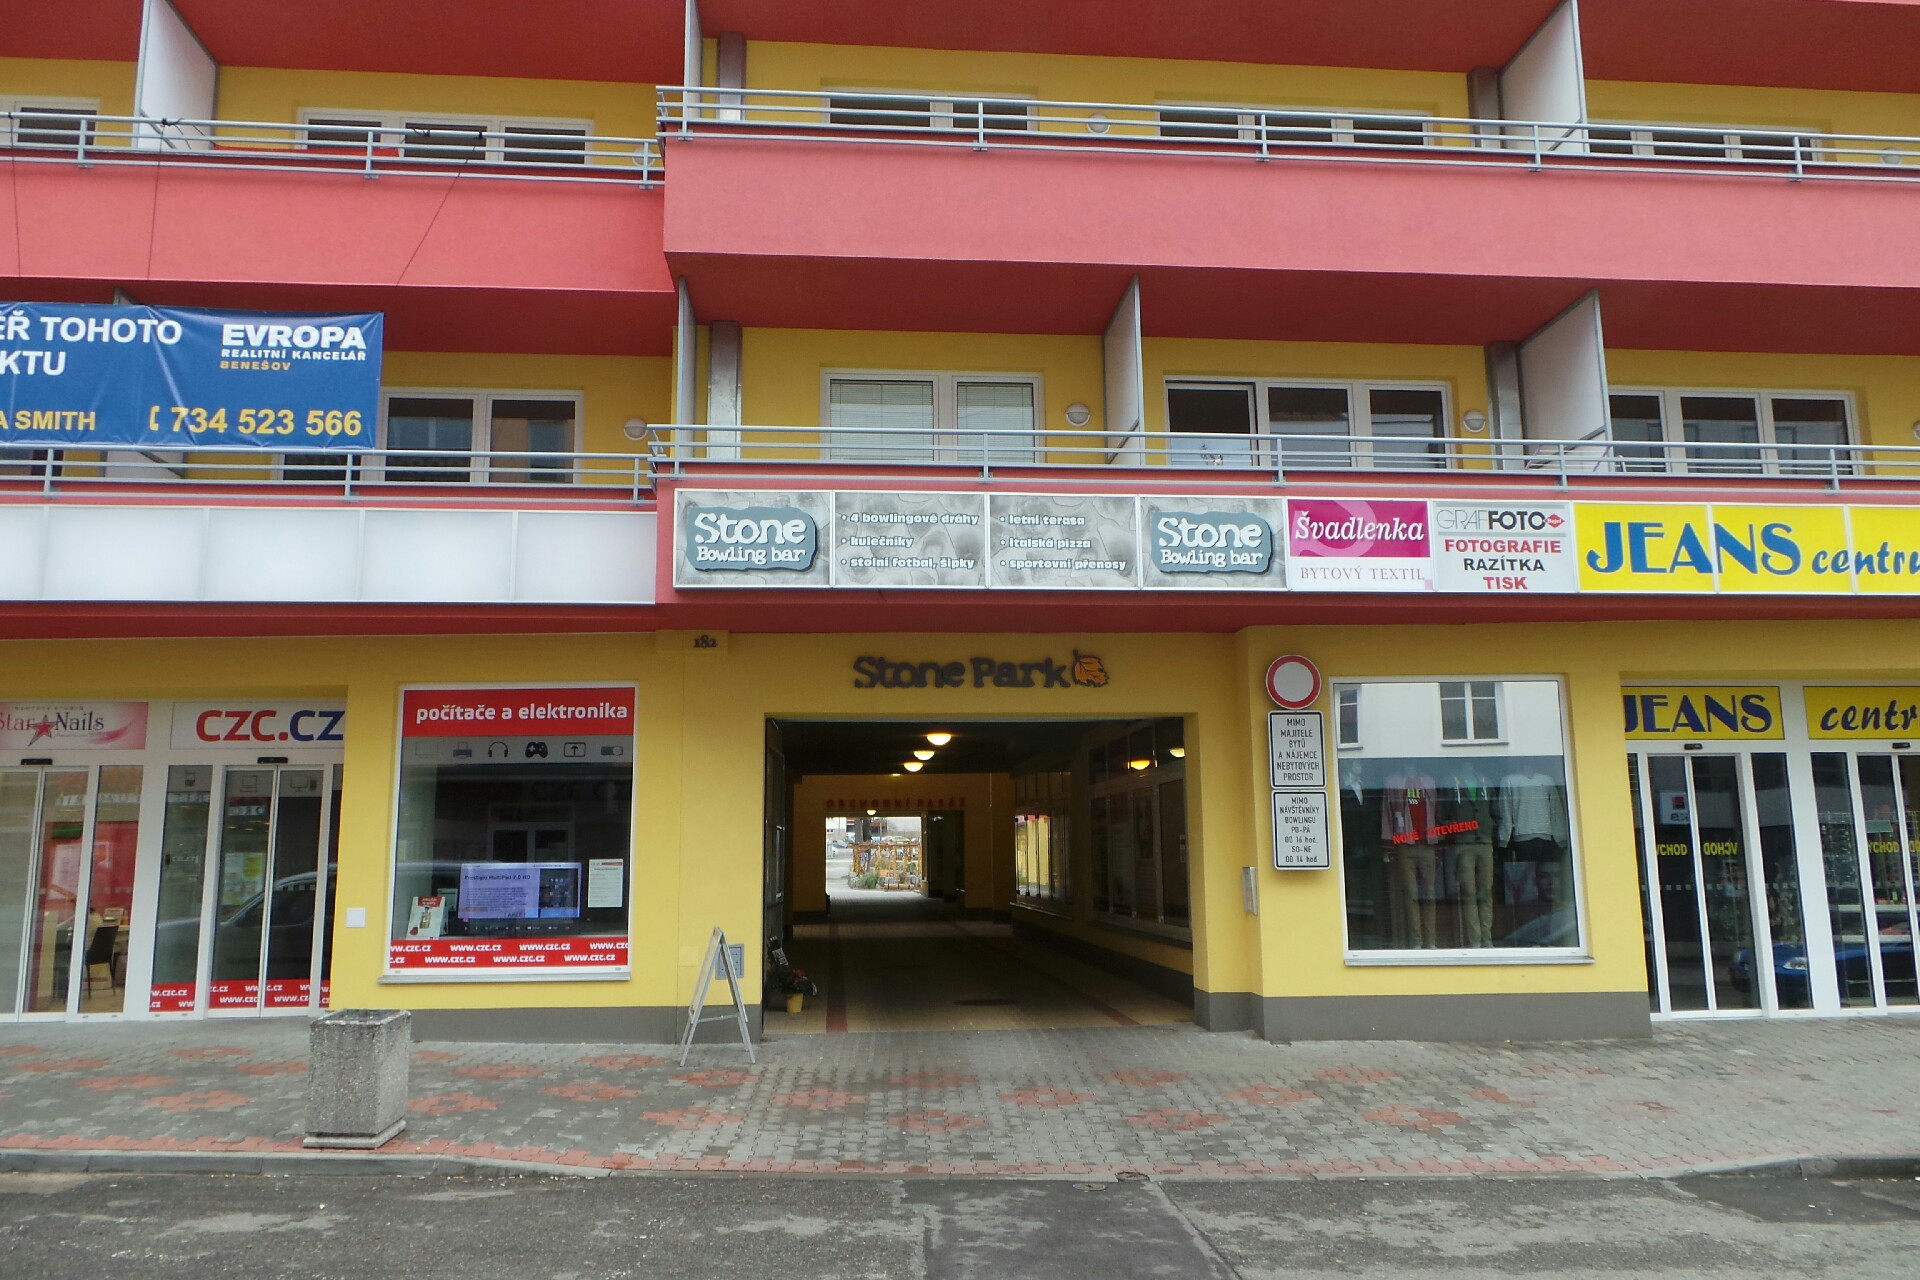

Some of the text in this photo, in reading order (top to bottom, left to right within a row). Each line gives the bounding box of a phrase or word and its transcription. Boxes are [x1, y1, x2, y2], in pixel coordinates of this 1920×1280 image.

[40, 316, 182, 345] TOHOTO
[222, 323, 367, 349] EVROPA
[221, 348, 366, 361] REALITNÍ KANCELÁŘ
[220, 360, 291, 371] BENEŠOV
[14, 410, 96, 431] SMITH
[171, 407, 362, 436] 734 523 566
[850, 513, 979, 525] 4 bowlingové dráhy
[1009, 514, 1085, 526] letní terasa
[694, 512, 806, 545] Stone
[1295, 510, 1425, 541] Švadlenka
[1158, 517, 1263, 548] Stone
[1057, 538, 1091, 550] pizza
[1444, 539, 1562, 554] FOTOGRAFIE
[1586, 521, 1801, 576] JEANS
[696, 546, 807, 565] Bowling bar
[1160, 549, 1263, 567] Bowling bar
[892, 557, 937, 569] fotbal,
[1009, 558, 1127, 570] sportovní přenosy
[1463, 555, 1546, 571] RAZÍTKA
[1300, 565, 1425, 580] BYTOVÝ TEXTIL
[1483, 576, 1528, 590] TISK
[693, 635, 717, 648] 182
[853, 656, 1071, 688] Stone Park
[416, 703, 628, 724] počítače a elektronika
[1622, 694, 1772, 733] JEANS
[55, 711, 105, 731] Nails
[1287, 718, 1305, 727] MIMO
[1281, 729, 1313, 738] MAJITELE
[1289, 738, 1305, 748] BYTŮ
[1278, 749, 1317, 759] A NÁJEMCE
[1277, 760, 1319, 770] NEBYTOVÝCH
[1284, 772, 1314, 781] PROSTOR
[1291, 797, 1308, 805] MIMO
[1285, 816, 1316, 824] BOWLINGU
[1291, 845, 1312, 853] SO-NE
[1286, 855, 1294, 863] OD
[450, 943, 502, 952] www.czc.cz
[519, 942, 571, 951] www.czc.cz
[425, 955, 476, 963] www.czc.cz
[493, 954, 545, 963] www.czc.cz
[564, 953, 615, 962] www.czc.cz
